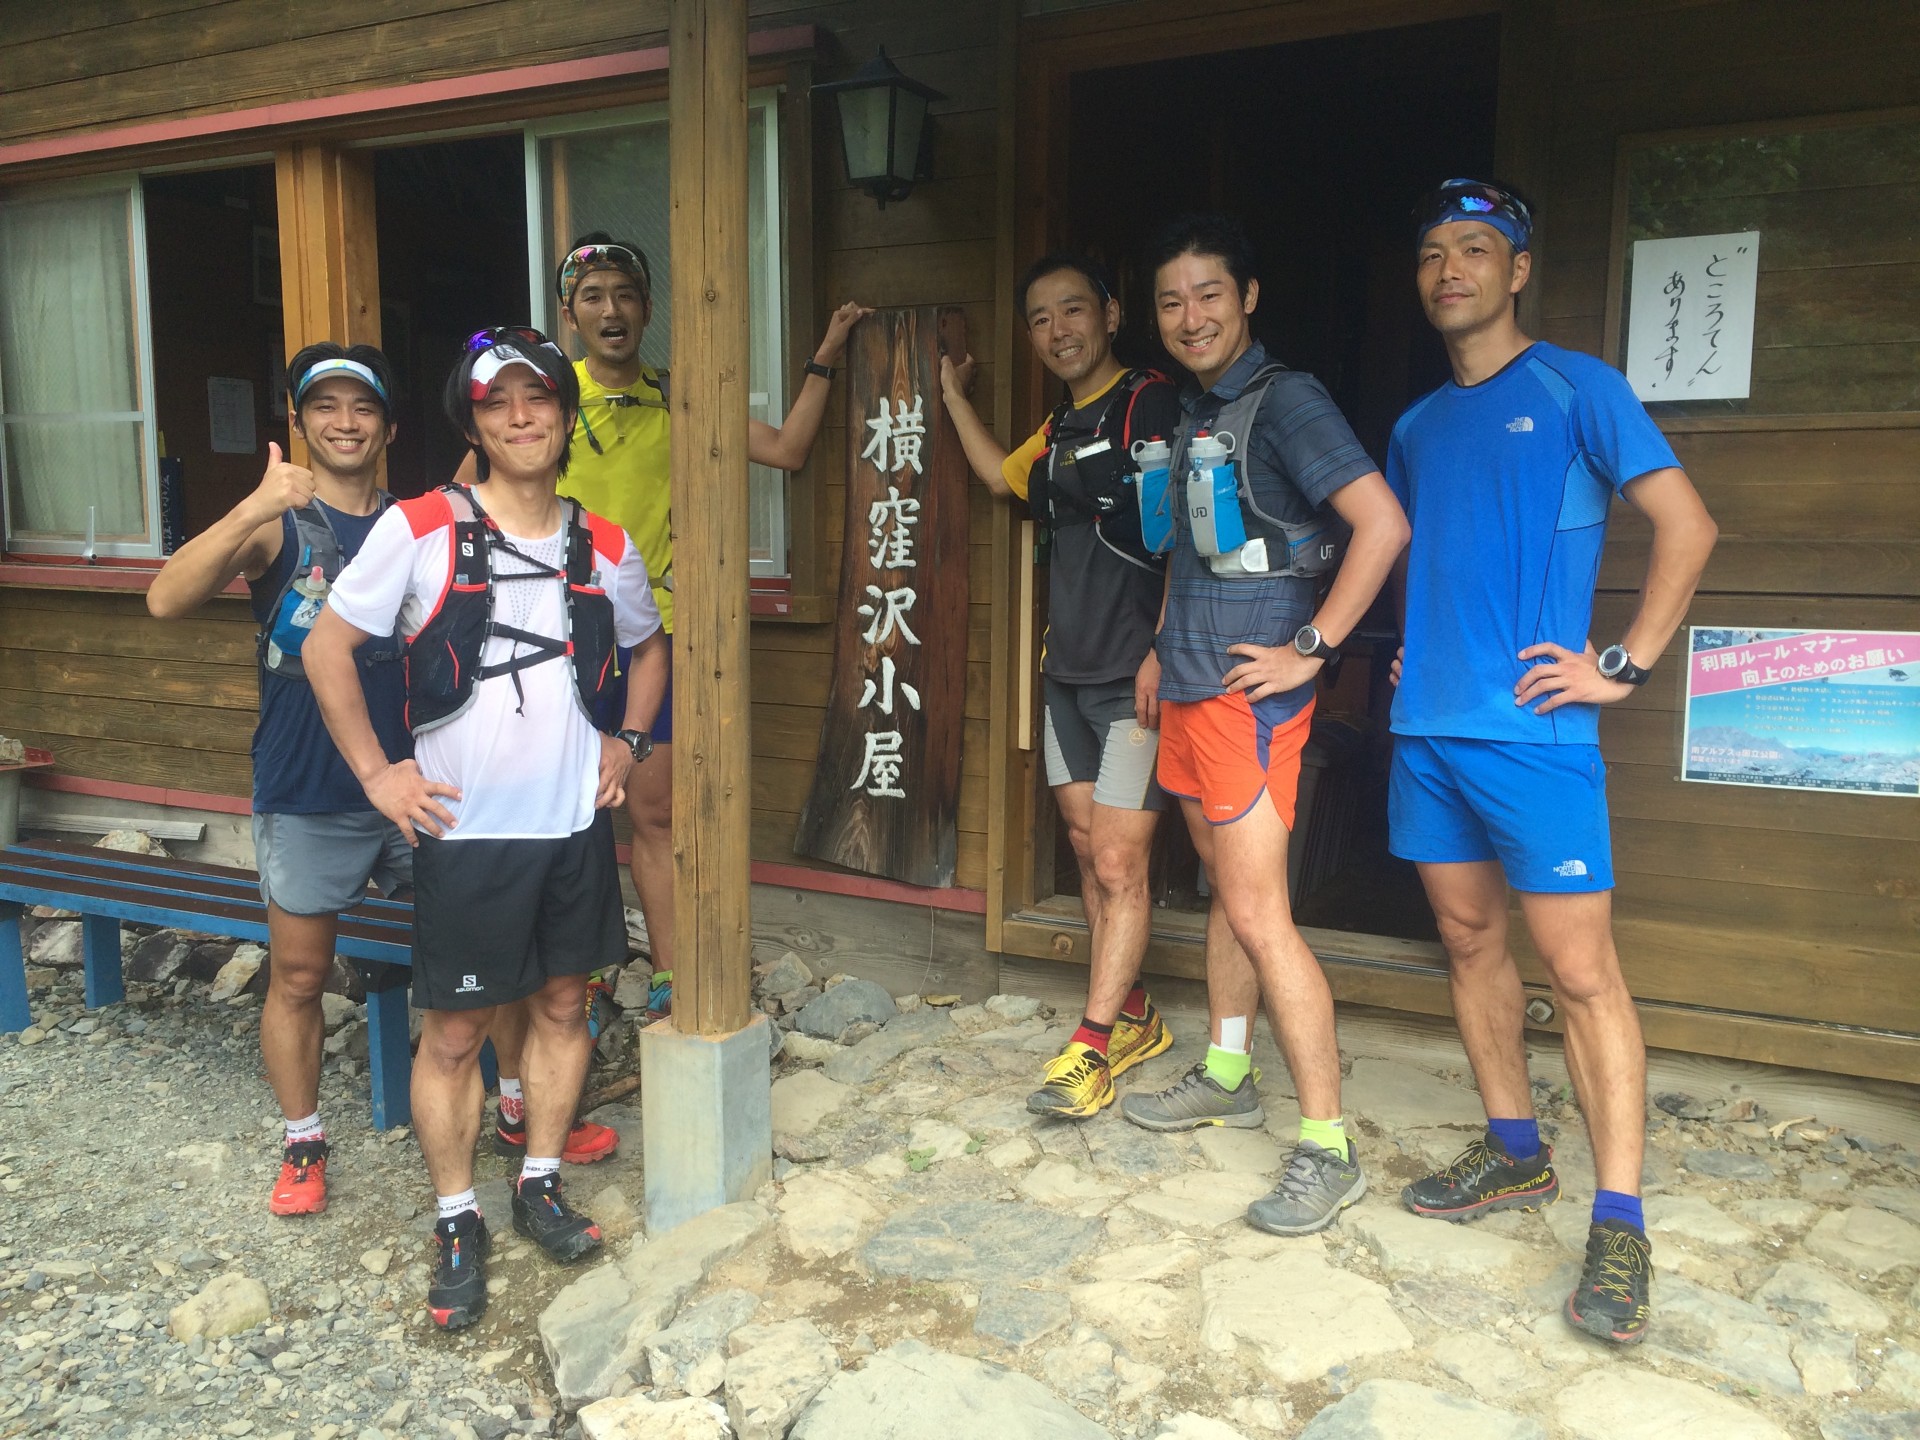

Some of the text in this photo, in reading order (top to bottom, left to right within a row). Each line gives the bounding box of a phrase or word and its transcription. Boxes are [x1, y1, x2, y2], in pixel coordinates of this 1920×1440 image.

[850, 395, 926, 799] 横窪沢小屋
[1700, 635, 1858, 672] 利用ルール・マナー
[1741, 647, 1905, 687] 向上のためのお願い
[1480, 1170, 1551, 1201] LA SPORTIVA
